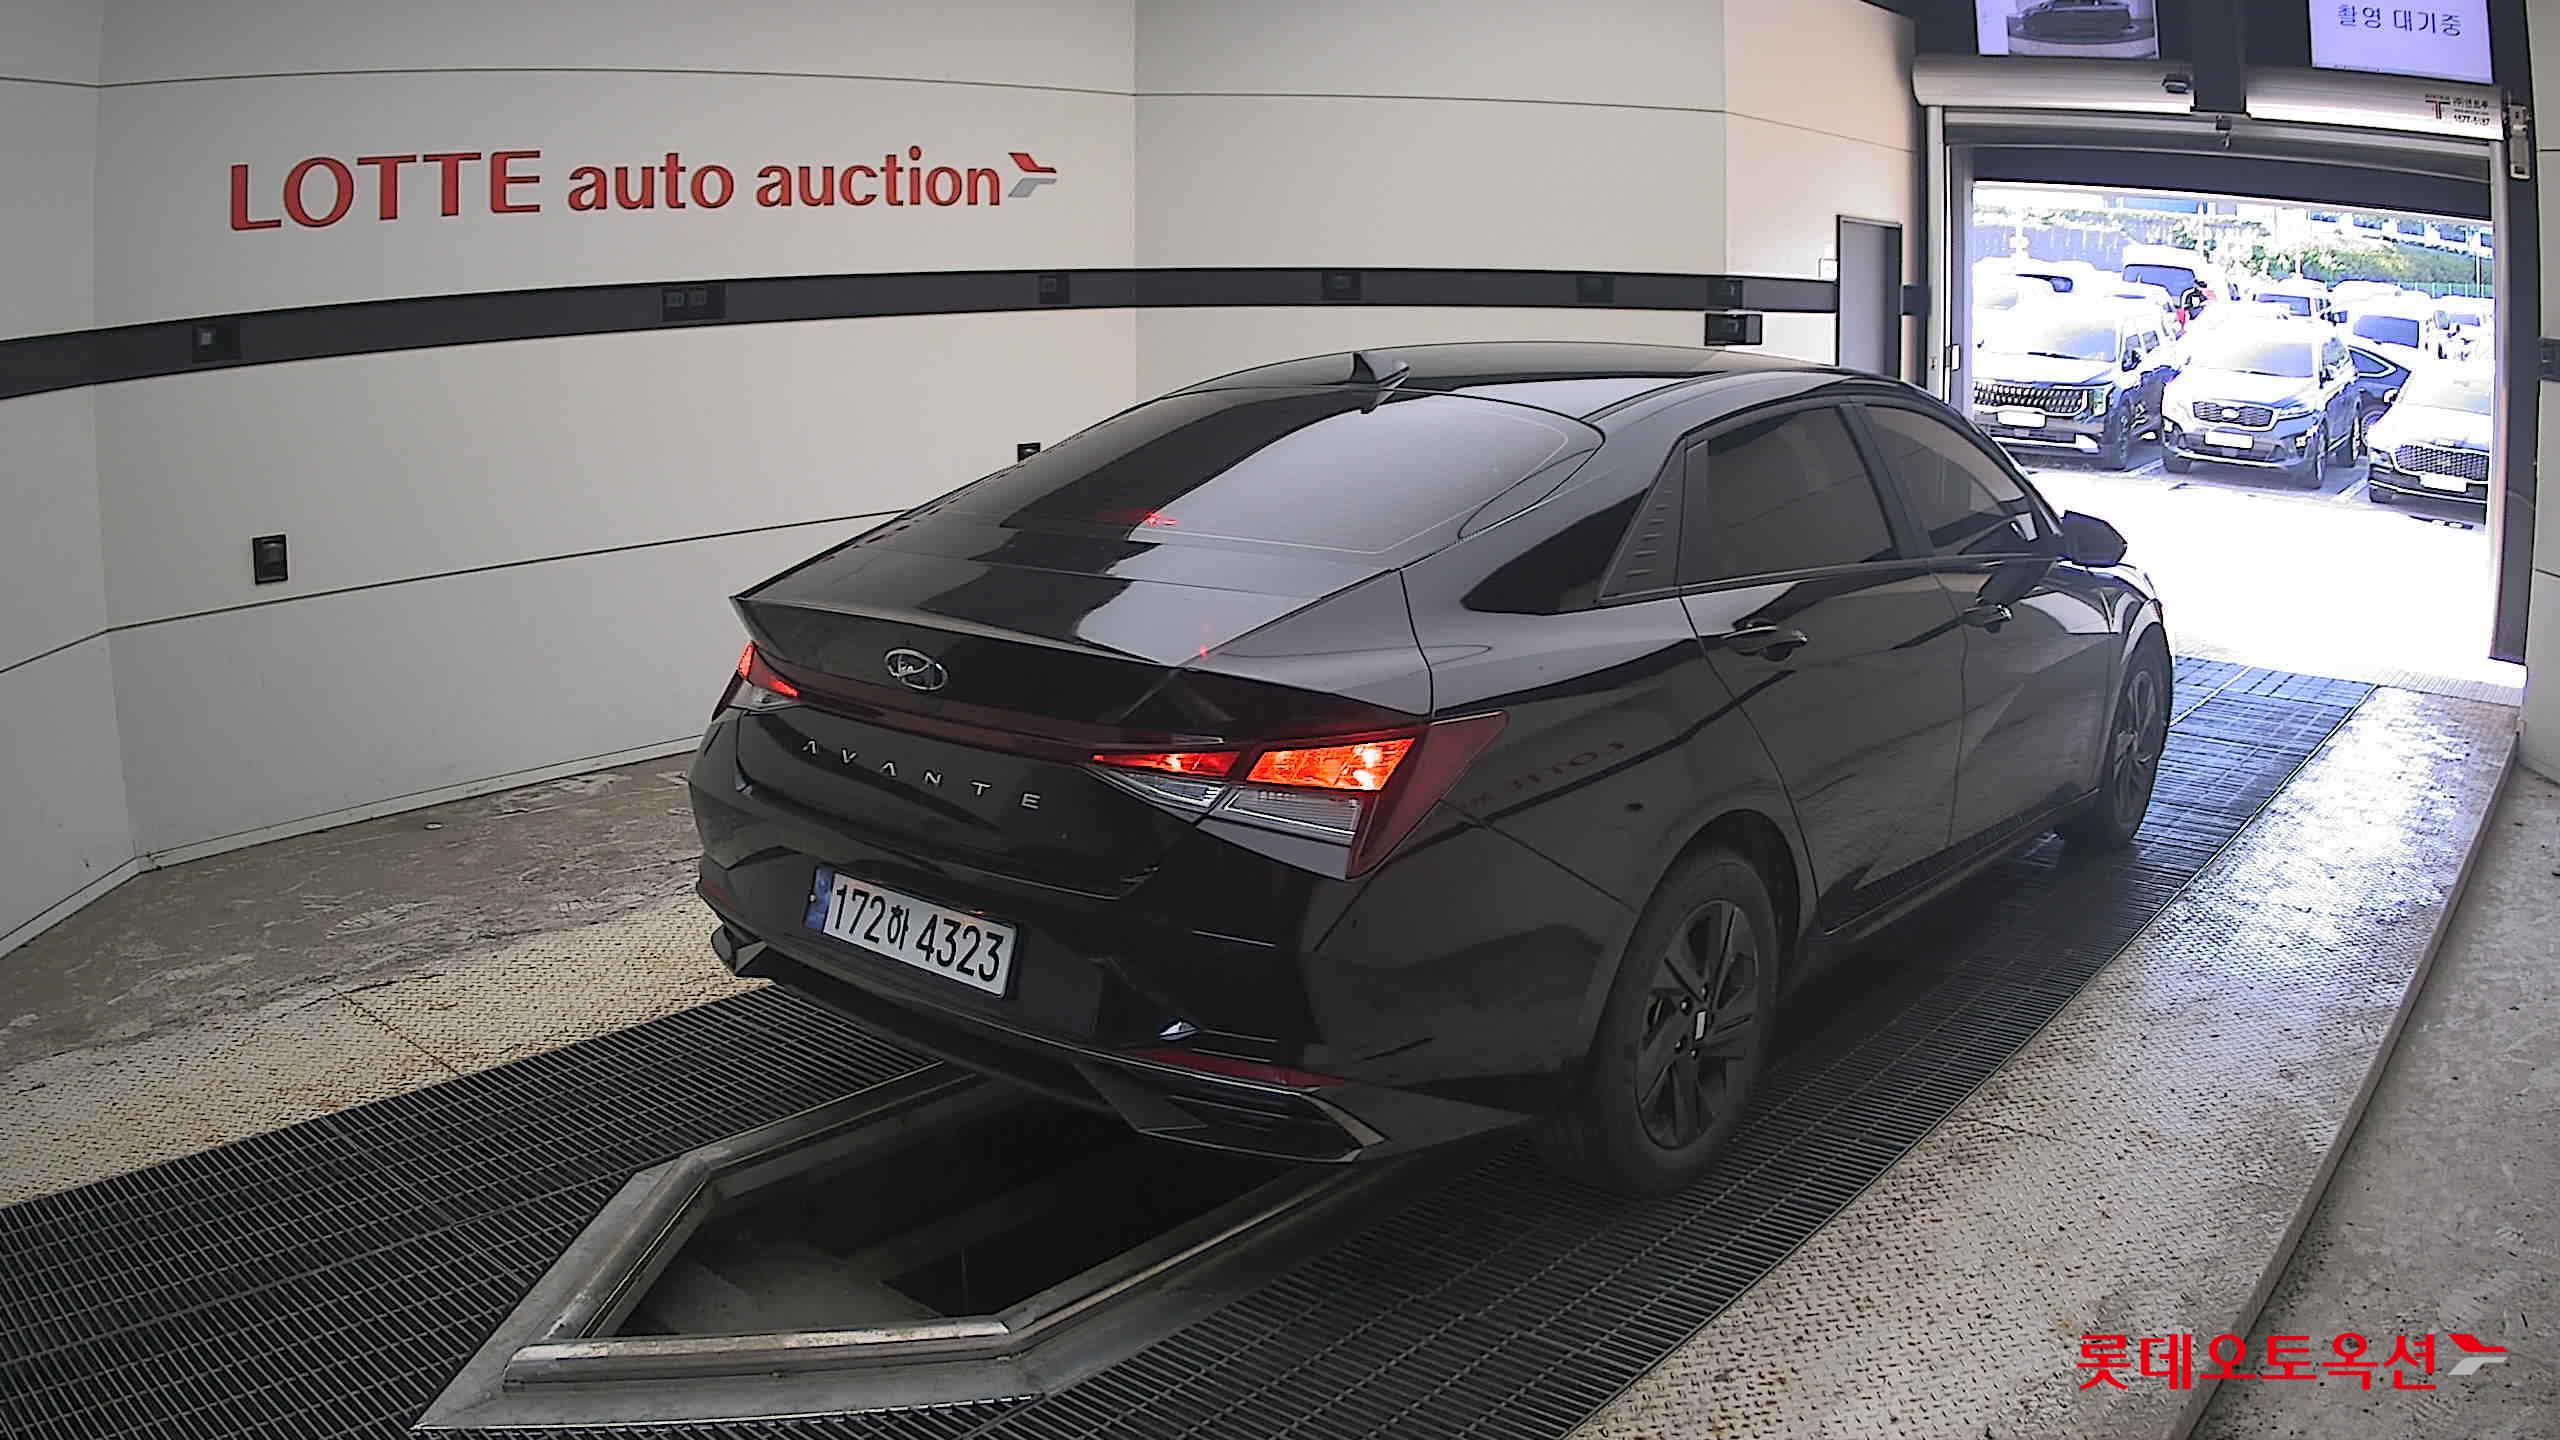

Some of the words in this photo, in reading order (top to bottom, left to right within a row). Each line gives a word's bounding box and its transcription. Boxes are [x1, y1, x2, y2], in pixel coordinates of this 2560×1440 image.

[2338, 4, 2383, 30] 촬영
[2392, 9, 2462, 37] 대기중
[230, 150, 541, 231] LOTTE
[568, 152, 734, 209] auto
[756, 146, 1001, 206] auction
[803, 740, 1041, 809] AVANTE
[834, 884, 910, 950] 172하
[916, 914, 1005, 982] 4323
